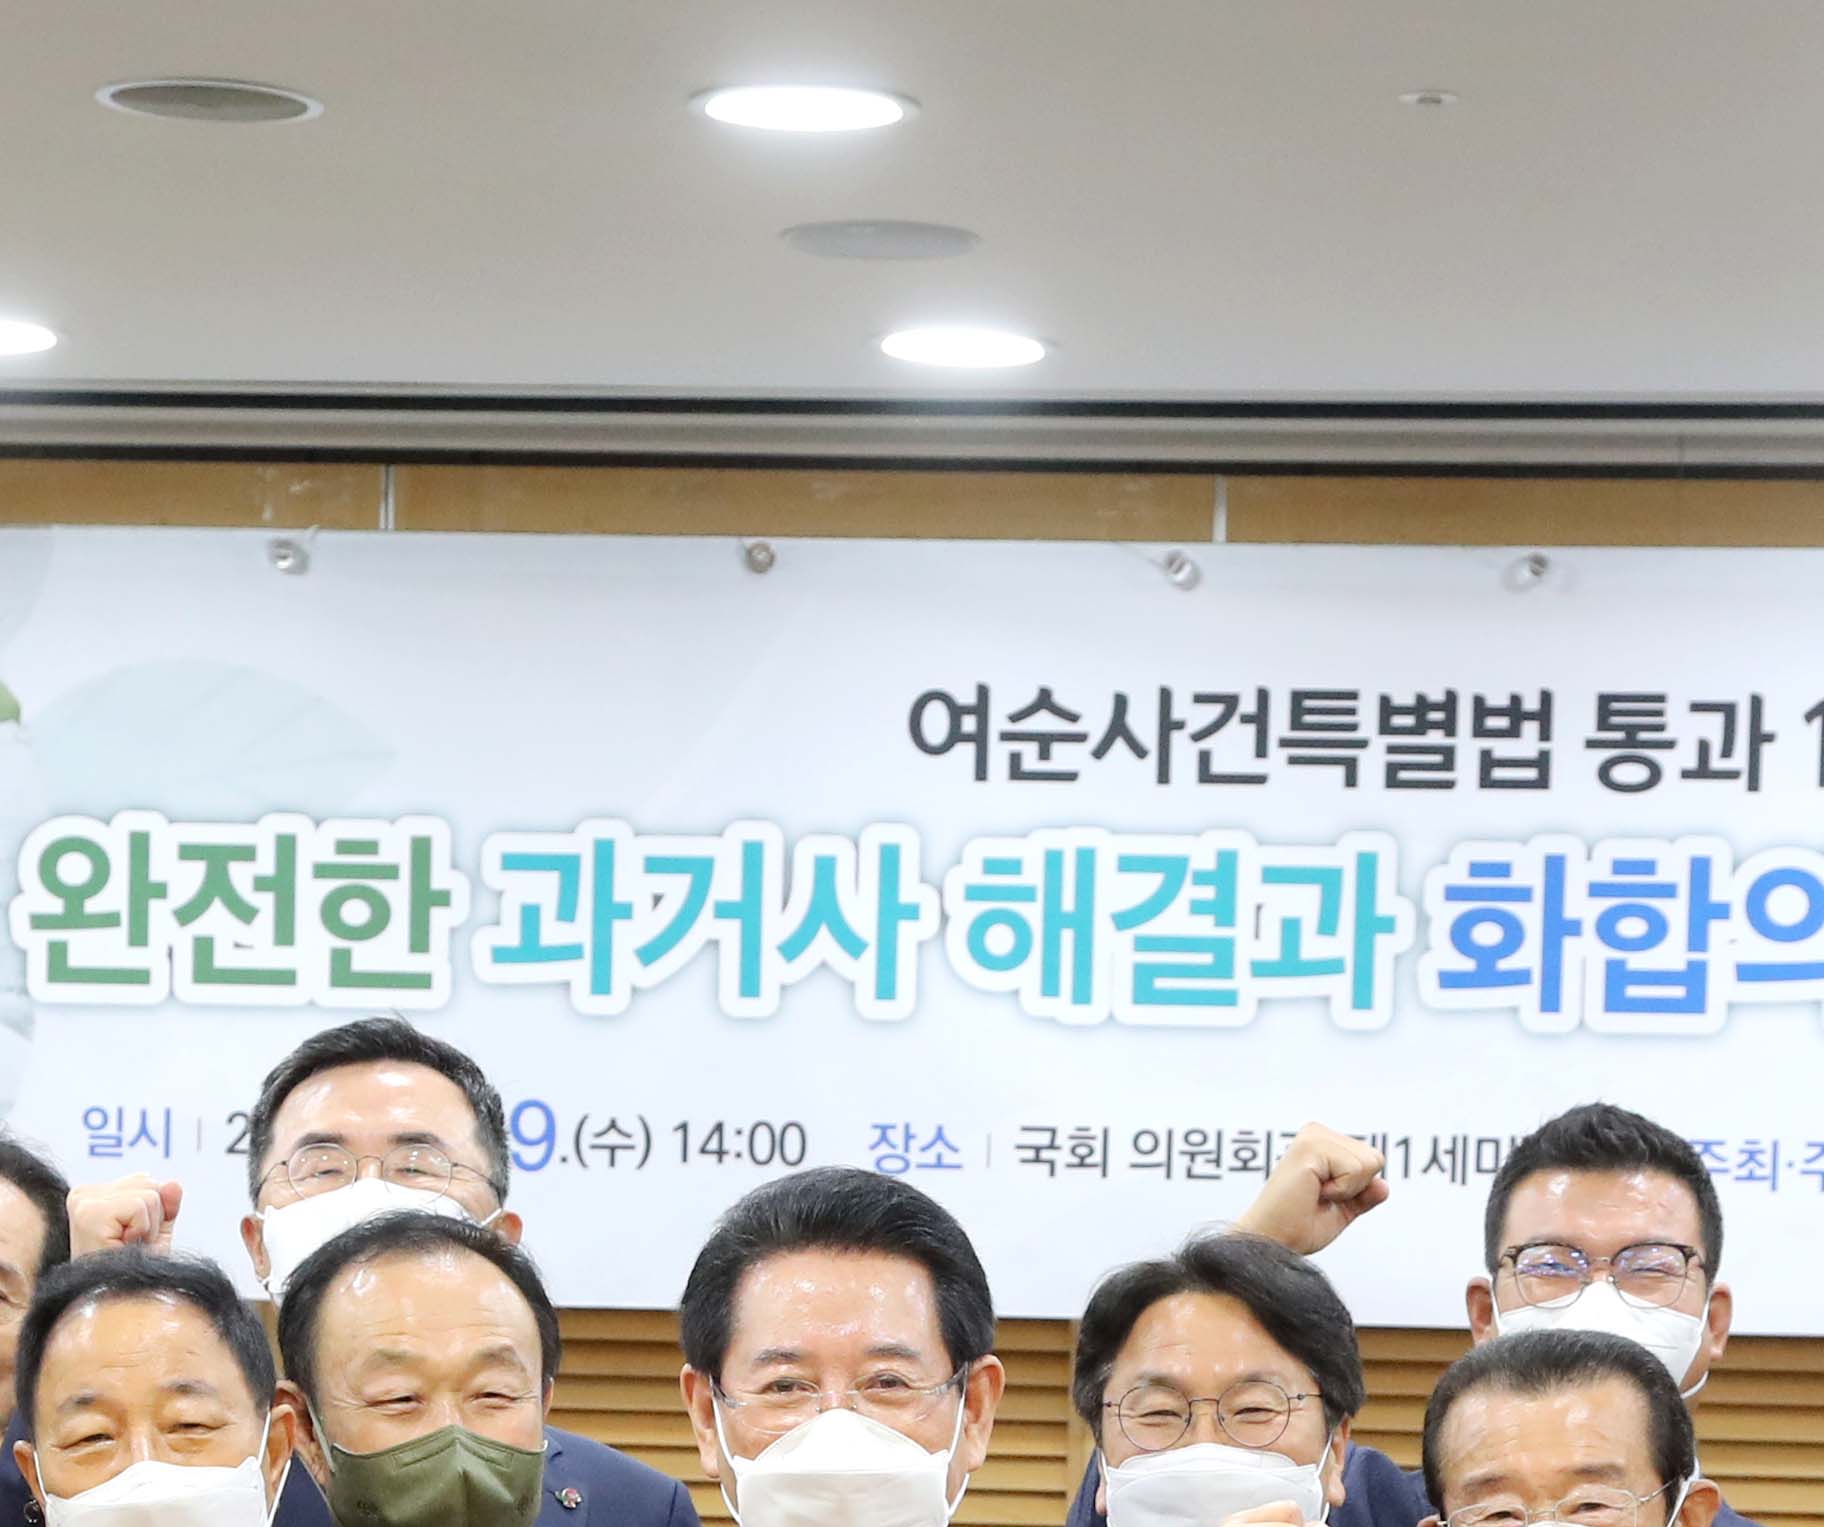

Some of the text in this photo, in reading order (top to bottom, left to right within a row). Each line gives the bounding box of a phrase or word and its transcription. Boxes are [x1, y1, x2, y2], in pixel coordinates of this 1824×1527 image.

[908, 683, 1554, 791] 여순사건특별법
[1583, 692, 1777, 794] 통과
[29, 832, 451, 989] 완전한
[491, 839, 921, 1001] 과거사
[963, 846, 1396, 1011] 해결과
[83, 1106, 172, 1158] 일시
[673, 1120, 809, 1168] 14:00
[870, 1122, 962, 1175] 장소
[1014, 1125, 1110, 1179] 국회
